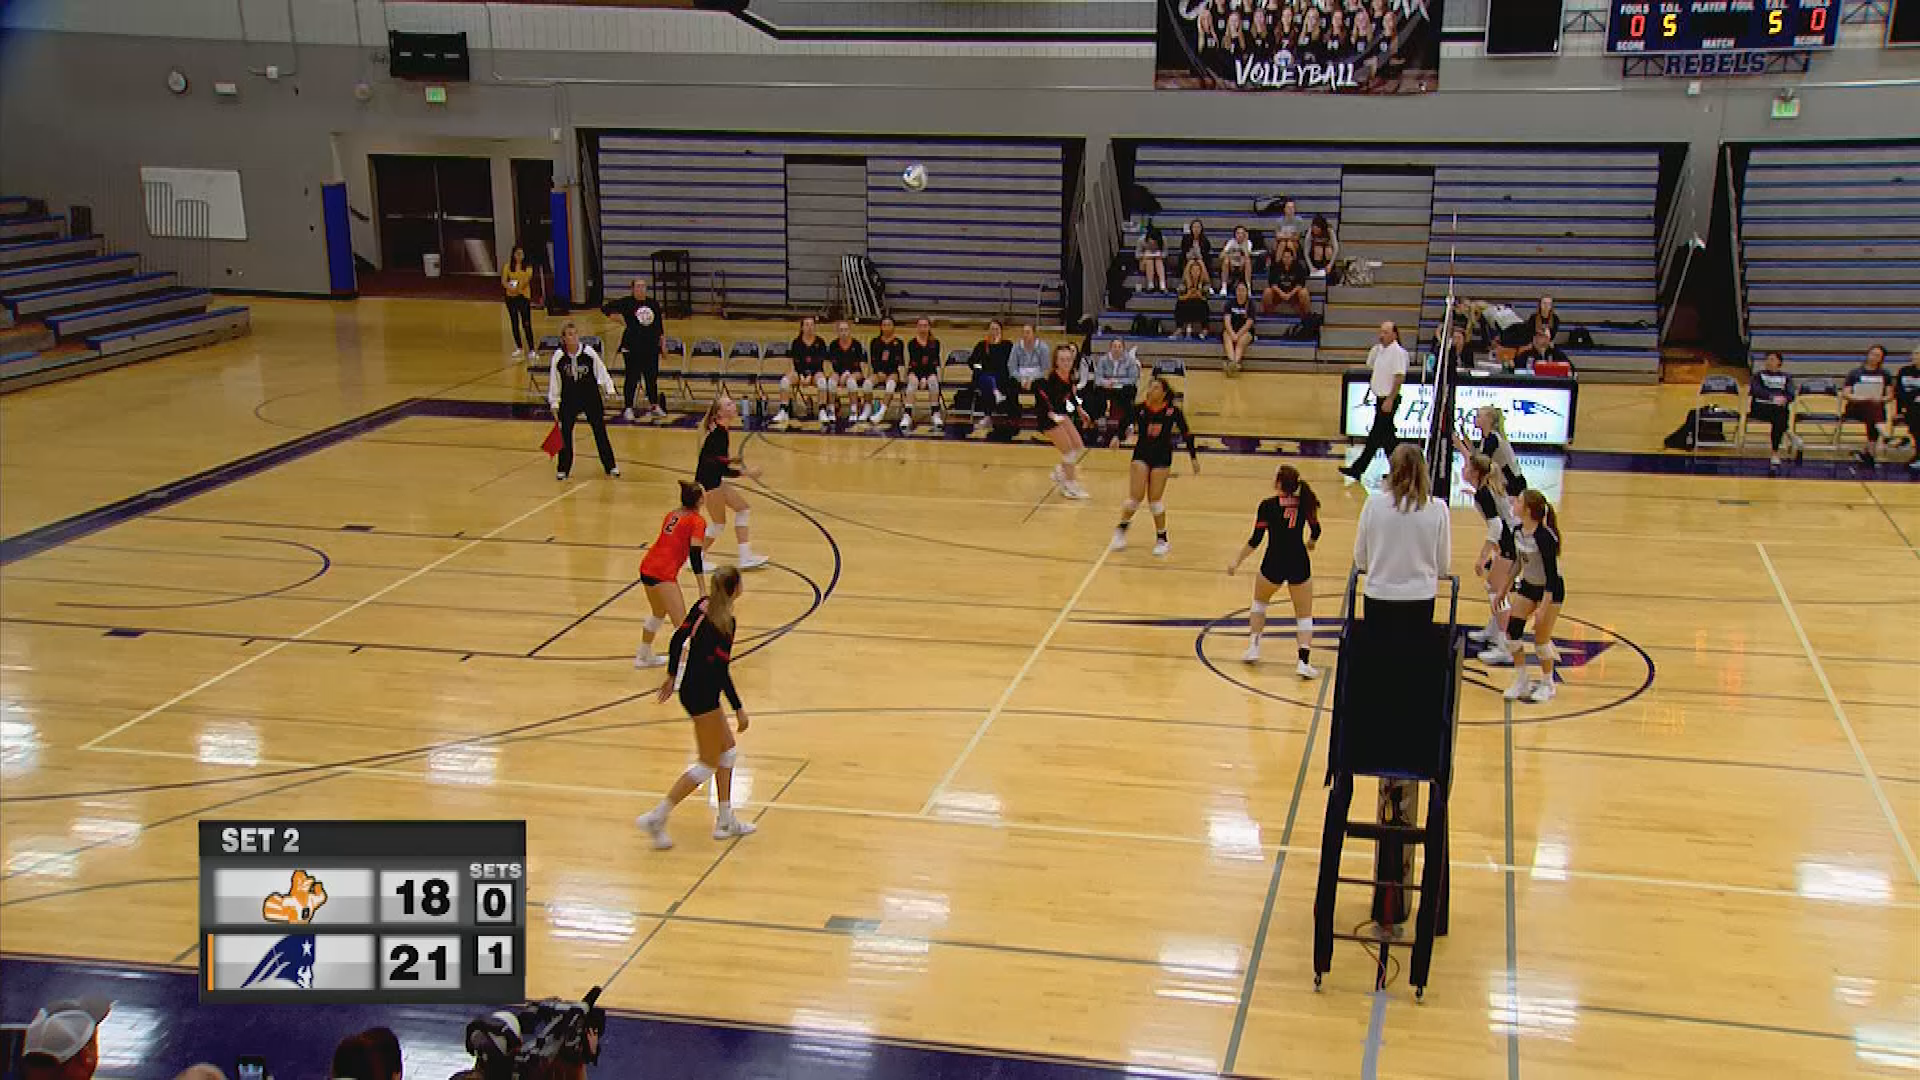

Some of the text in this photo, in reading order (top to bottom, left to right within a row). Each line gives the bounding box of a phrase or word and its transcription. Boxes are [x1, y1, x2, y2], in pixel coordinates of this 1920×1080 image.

[1620, 4, 1649, 14] FOULS
[1691, 1, 1754, 12] PLAYER FOUL
[1630, 14, 1645, 37] 0
[1663, 14, 1677, 37] 5
[1768, 10, 1782, 34] 5
[1810, 8, 1826, 30] 0
[1616, 40, 1645, 50] SCORE
[1702, 38, 1735, 49] MATCH
[1235, 54, 1358, 90] VOLLEYBALL
[1665, 53, 1765, 74] REBELS
[664, 515, 679, 533] 2
[1283, 507, 1298, 529] 7
